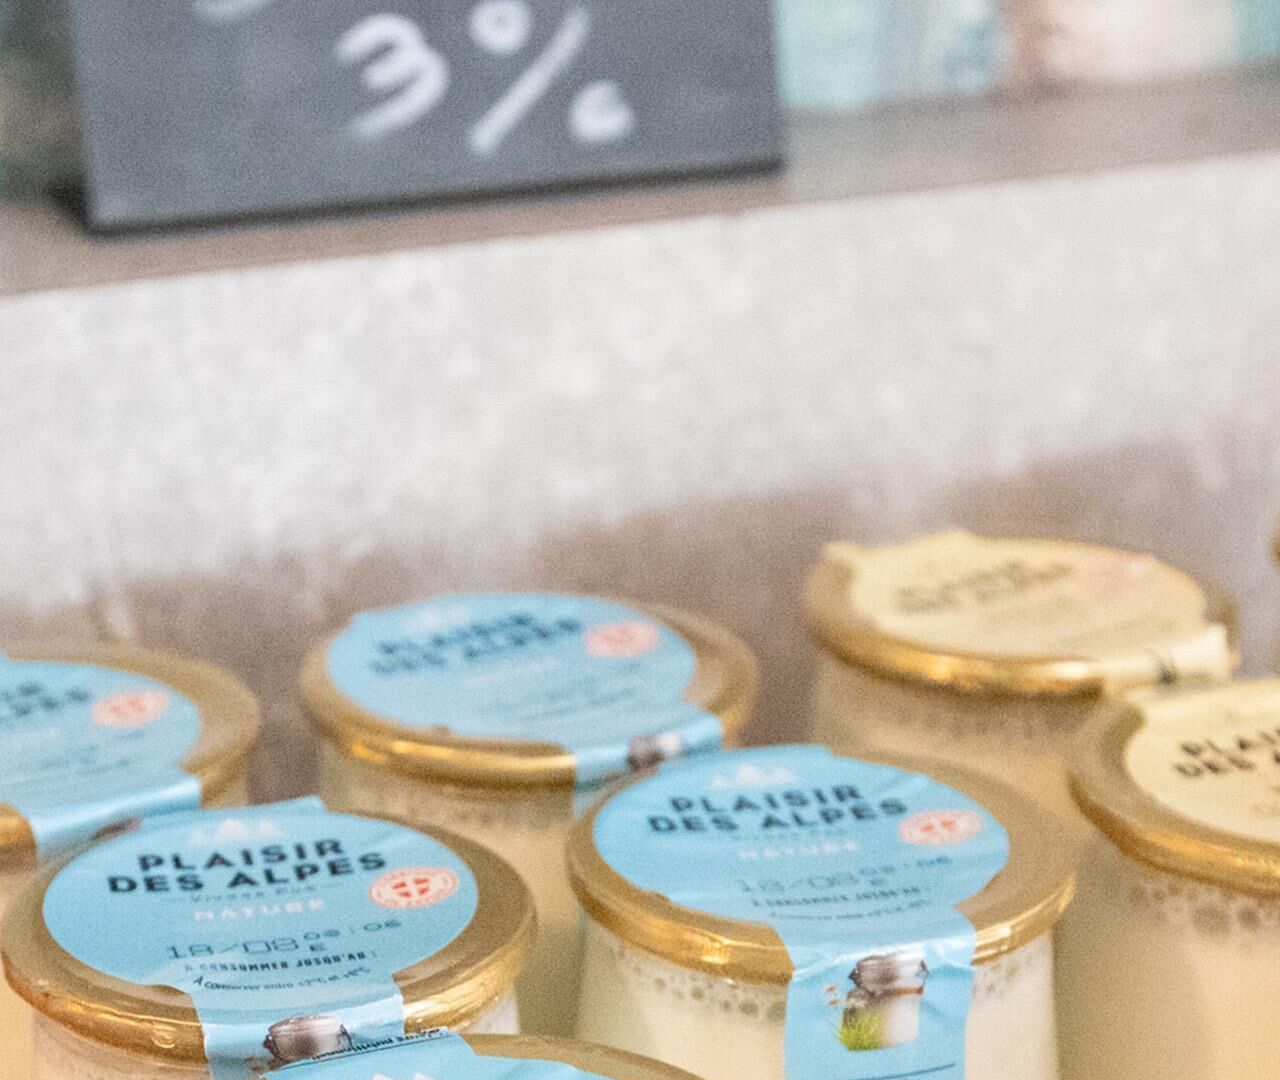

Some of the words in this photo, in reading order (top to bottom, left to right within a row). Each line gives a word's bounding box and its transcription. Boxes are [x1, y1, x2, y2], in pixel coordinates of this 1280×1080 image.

[1174, 756, 1252, 779] DES
[671, 785, 863, 813] PLAISIR
[648, 815, 738, 832] DES
[761, 798, 907, 829] ALPES
[137, 839, 343, 872] PLAISIR
[107, 874, 204, 893] DES
[227, 852, 386, 888] ALPES
[194, 899, 325, 921] NATURE
[169, 936, 299, 959] 18/08
[199, 961, 289, 972] CONSOMMER
[296, 951, 367, 968] JUSQU'AU
[204, 981, 260, 991] conserver
